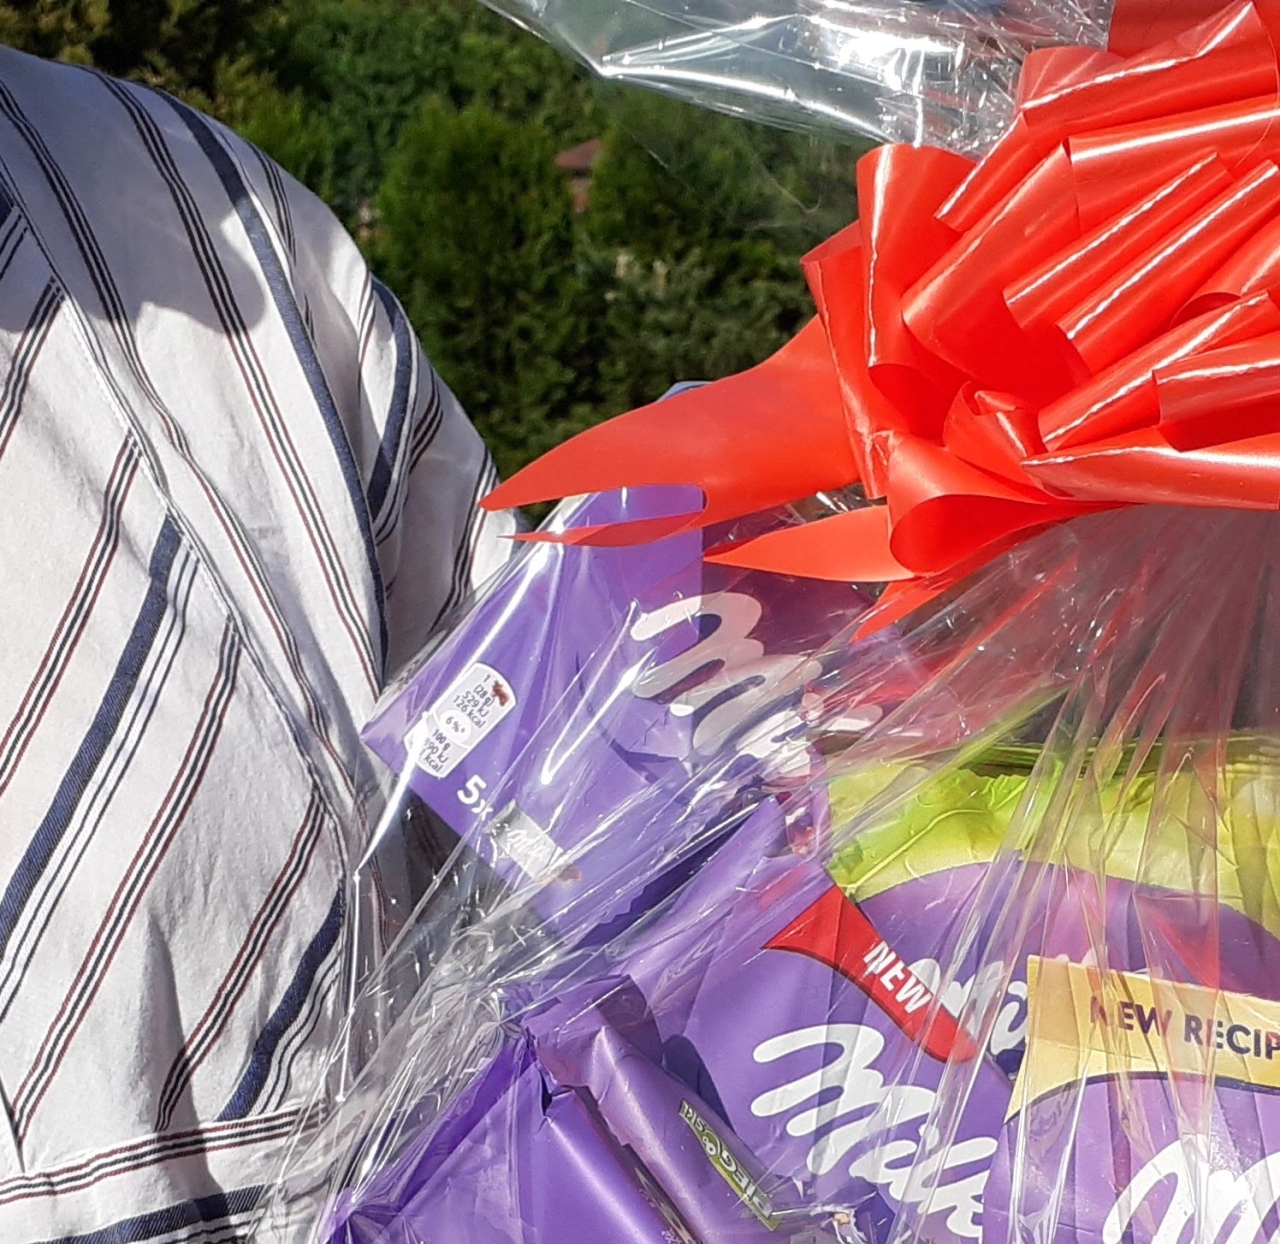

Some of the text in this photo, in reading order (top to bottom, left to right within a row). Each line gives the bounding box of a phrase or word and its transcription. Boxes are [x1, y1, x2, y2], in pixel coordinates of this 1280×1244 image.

[452, 695, 487, 729] 126 kcal
[462, 691, 480, 709] 529
[863, 941, 934, 1014] NEW
[1090, 996, 1173, 1037] NEW
